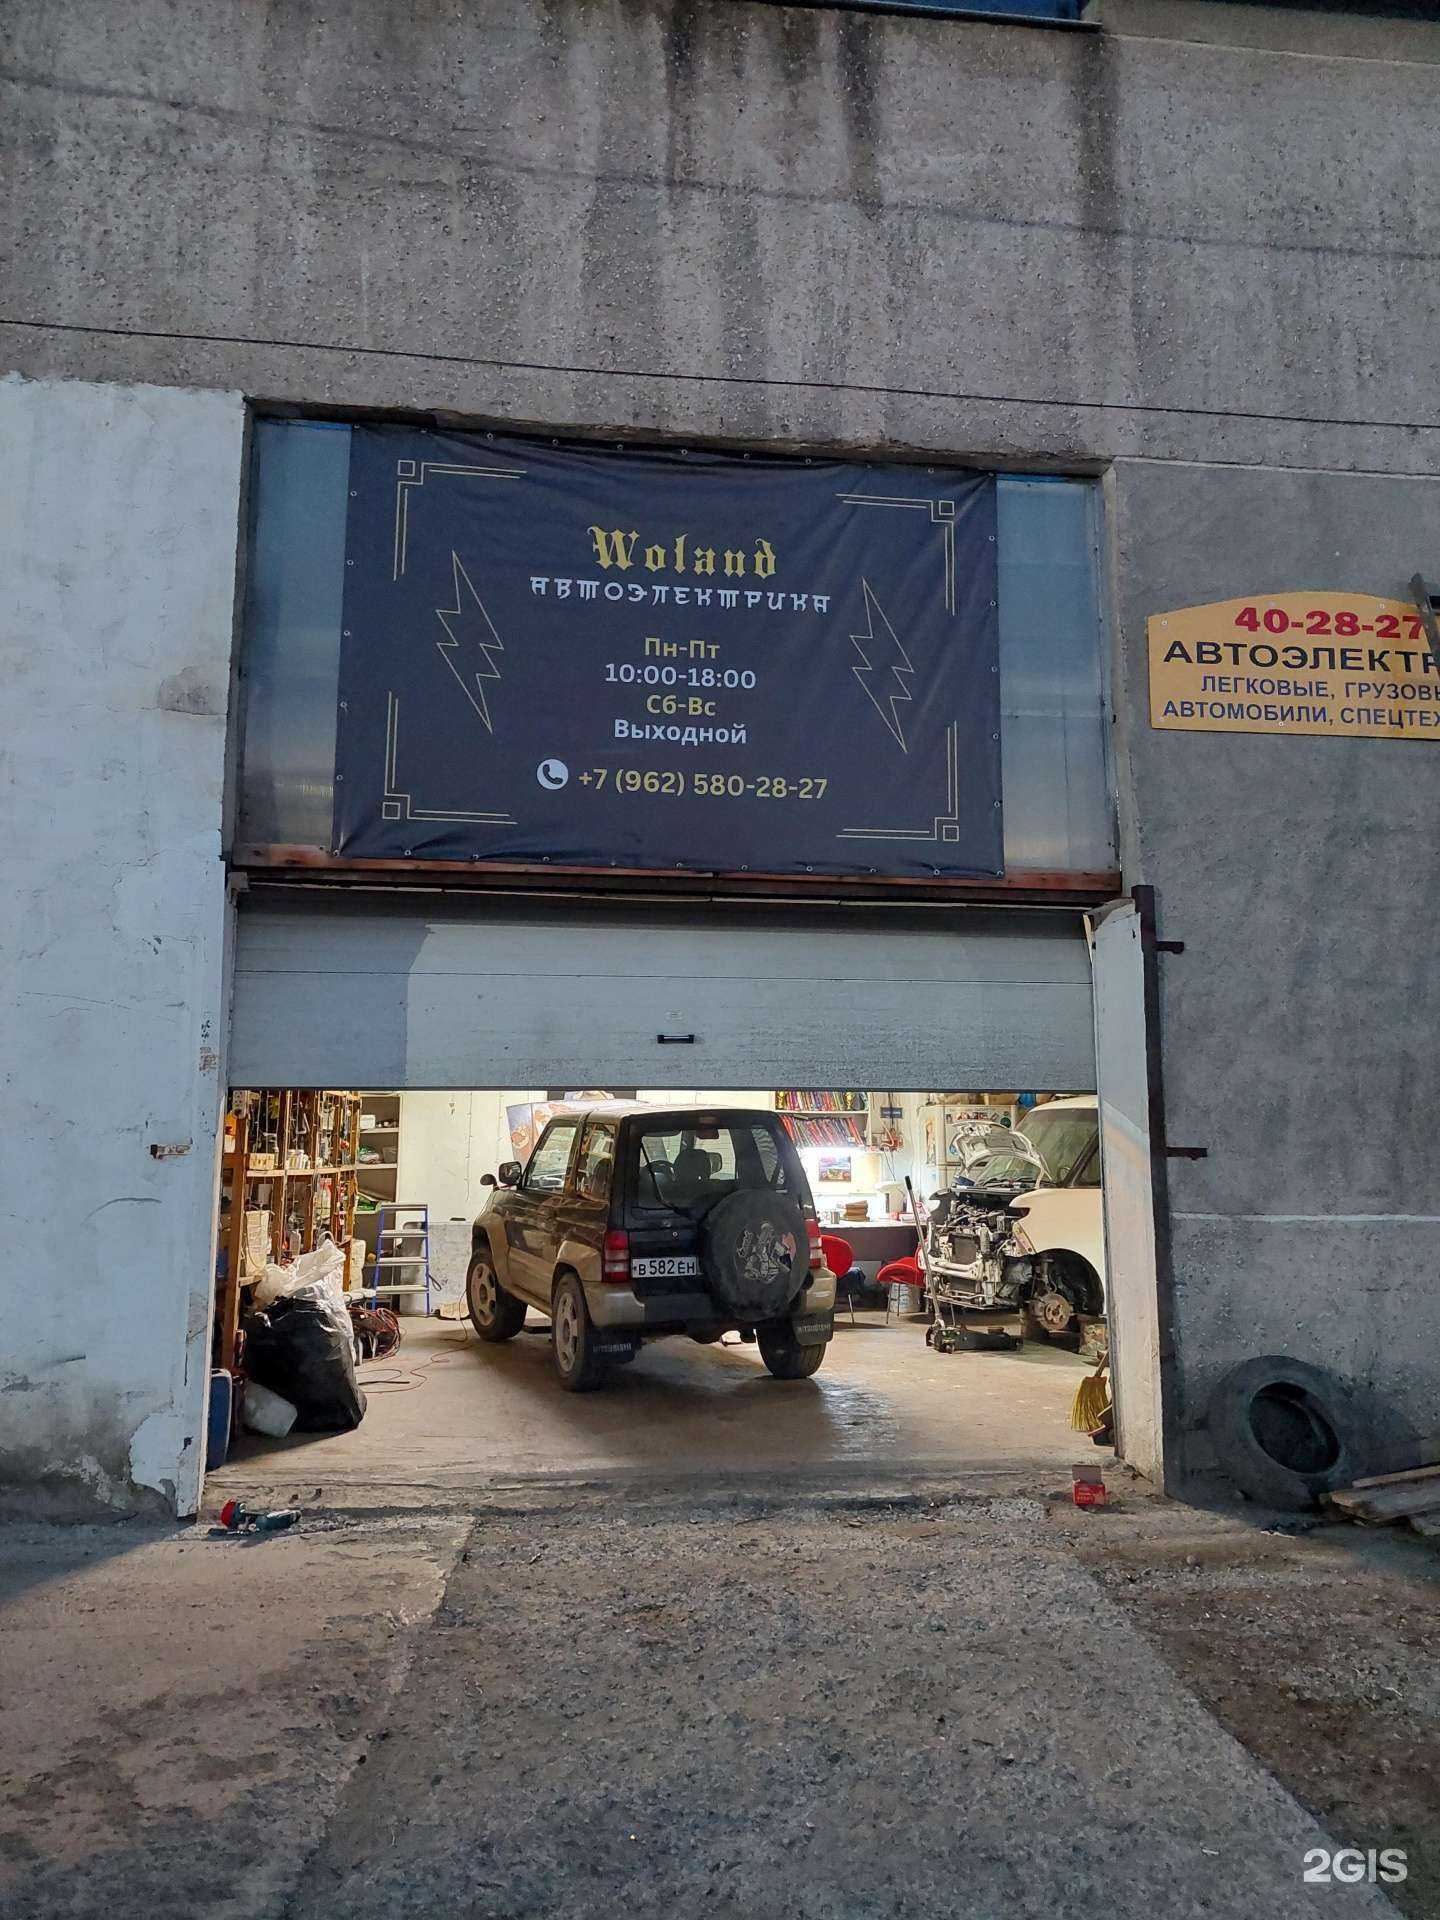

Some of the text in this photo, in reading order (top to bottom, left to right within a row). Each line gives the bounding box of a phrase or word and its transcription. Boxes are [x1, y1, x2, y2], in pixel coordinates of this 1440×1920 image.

[587, 526, 776, 579] Woland
[530, 576, 831, 613] АВТОЭЛЕКТРИКА
[1234, 607, 1424, 640] 40-28-27
[644, 637, 720, 659] Пн-Пт
[605, 663, 757, 689] 10:00-18:00
[1201, 675, 1335, 700] ЛЕГКОВЫЕ,
[646, 694, 716, 716] Сб-Вс
[1162, 700, 1333, 726] АВТОМОБИЛИ,
[614, 719, 747, 746] Выходной
[578, 768, 828, 799] +7 (962) 580-28-27
